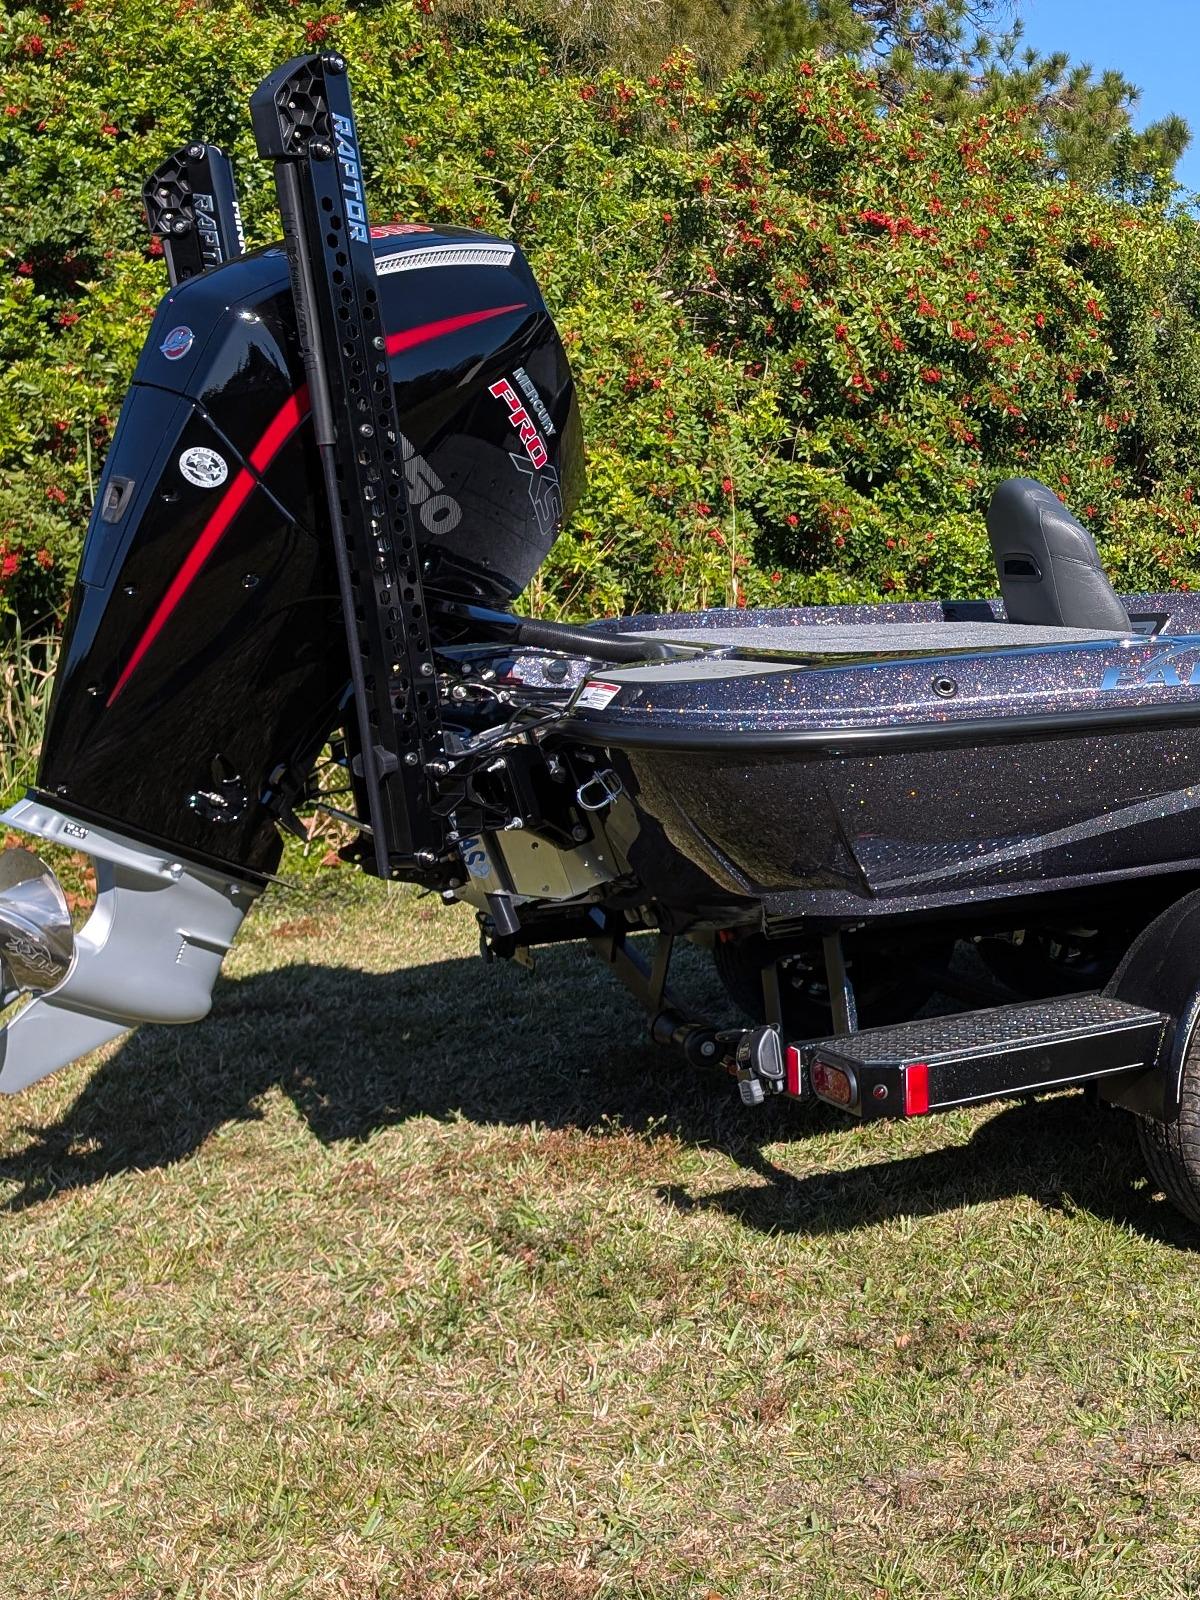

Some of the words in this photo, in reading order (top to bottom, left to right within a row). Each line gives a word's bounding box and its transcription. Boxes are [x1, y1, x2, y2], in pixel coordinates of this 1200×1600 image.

[332, 112, 368, 244] RAPTOR
[193, 193, 223, 267] RAPT
[232, 202, 246, 254] MINN
[488, 378, 547, 469] PRO
[512, 367, 556, 436] MERCURY
[509, 452, 563, 535] XS
